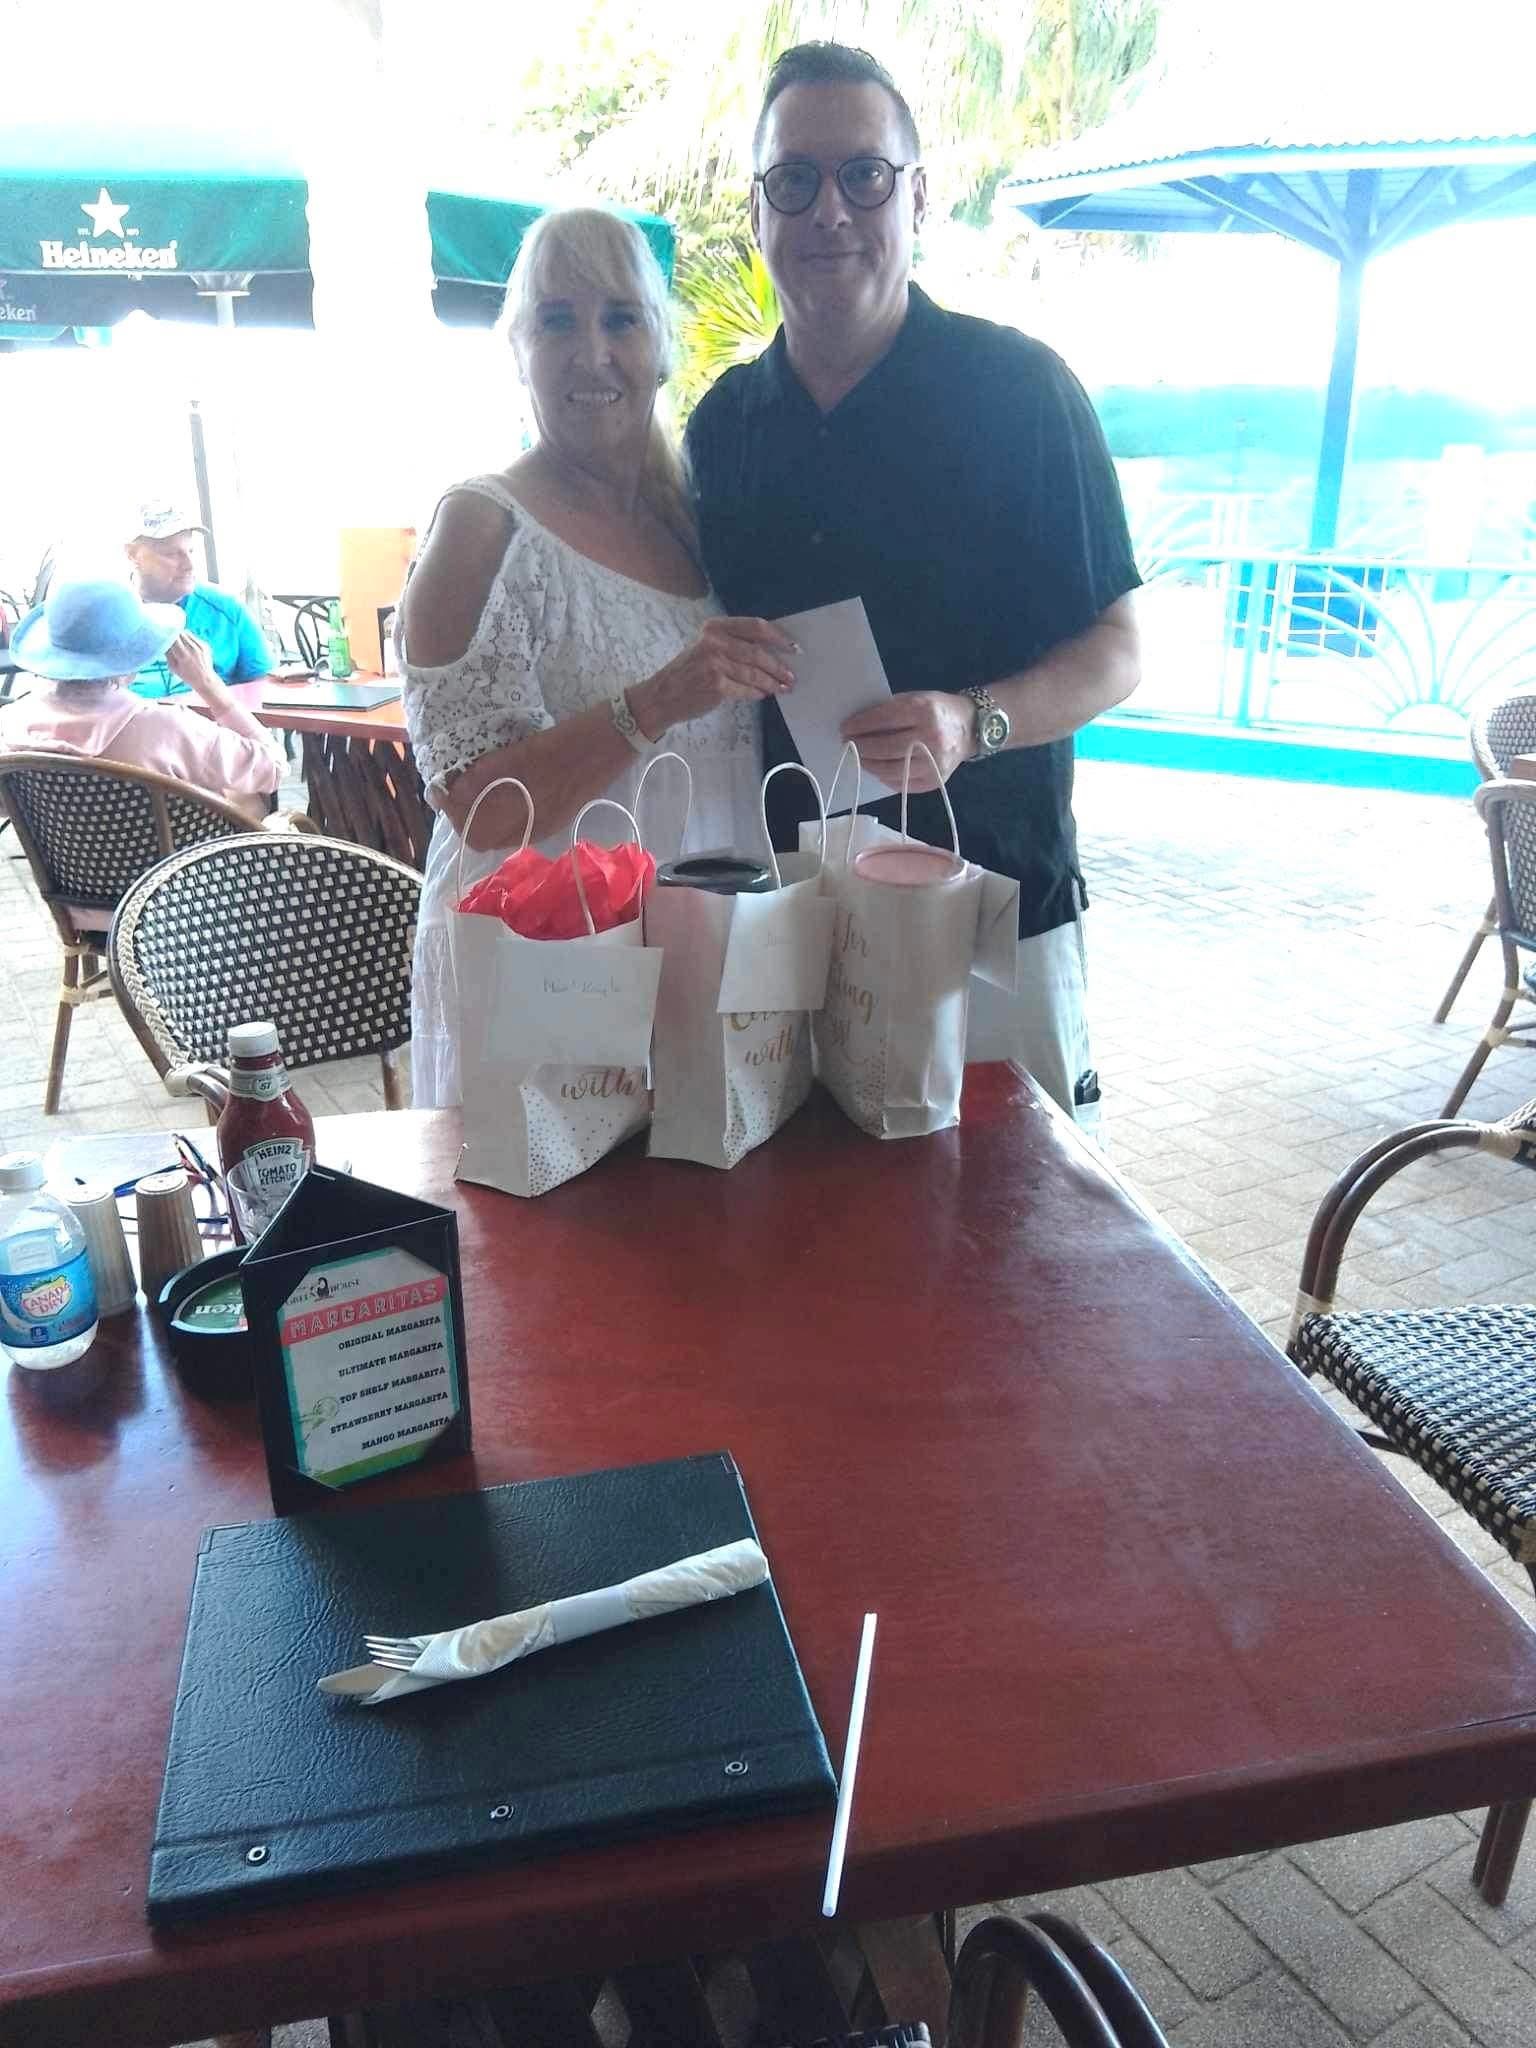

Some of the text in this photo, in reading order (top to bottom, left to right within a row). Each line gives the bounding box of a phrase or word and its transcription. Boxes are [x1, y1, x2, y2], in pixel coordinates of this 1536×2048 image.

[39, 239, 178, 269] Heineken
[560, 1067, 635, 1100] with
[257, 1144, 292, 1160] HEINZ
[258, 1162, 297, 1178] TOMATO
[39, 1296, 63, 1314] DRY
[290, 1283, 438, 1338] MARGARITAS
[338, 1315, 441, 1350] ORIGINAL MARGARITA
[338, 1341, 444, 1377] ULTIMATE MARGARITA
[340, 1366, 446, 1404] TOP SHELF MARGARITA
[330, 1391, 448, 1434] STRAWBERRY MARGARITA
[362, 1416, 450, 1450] MANGO MARGARITA
